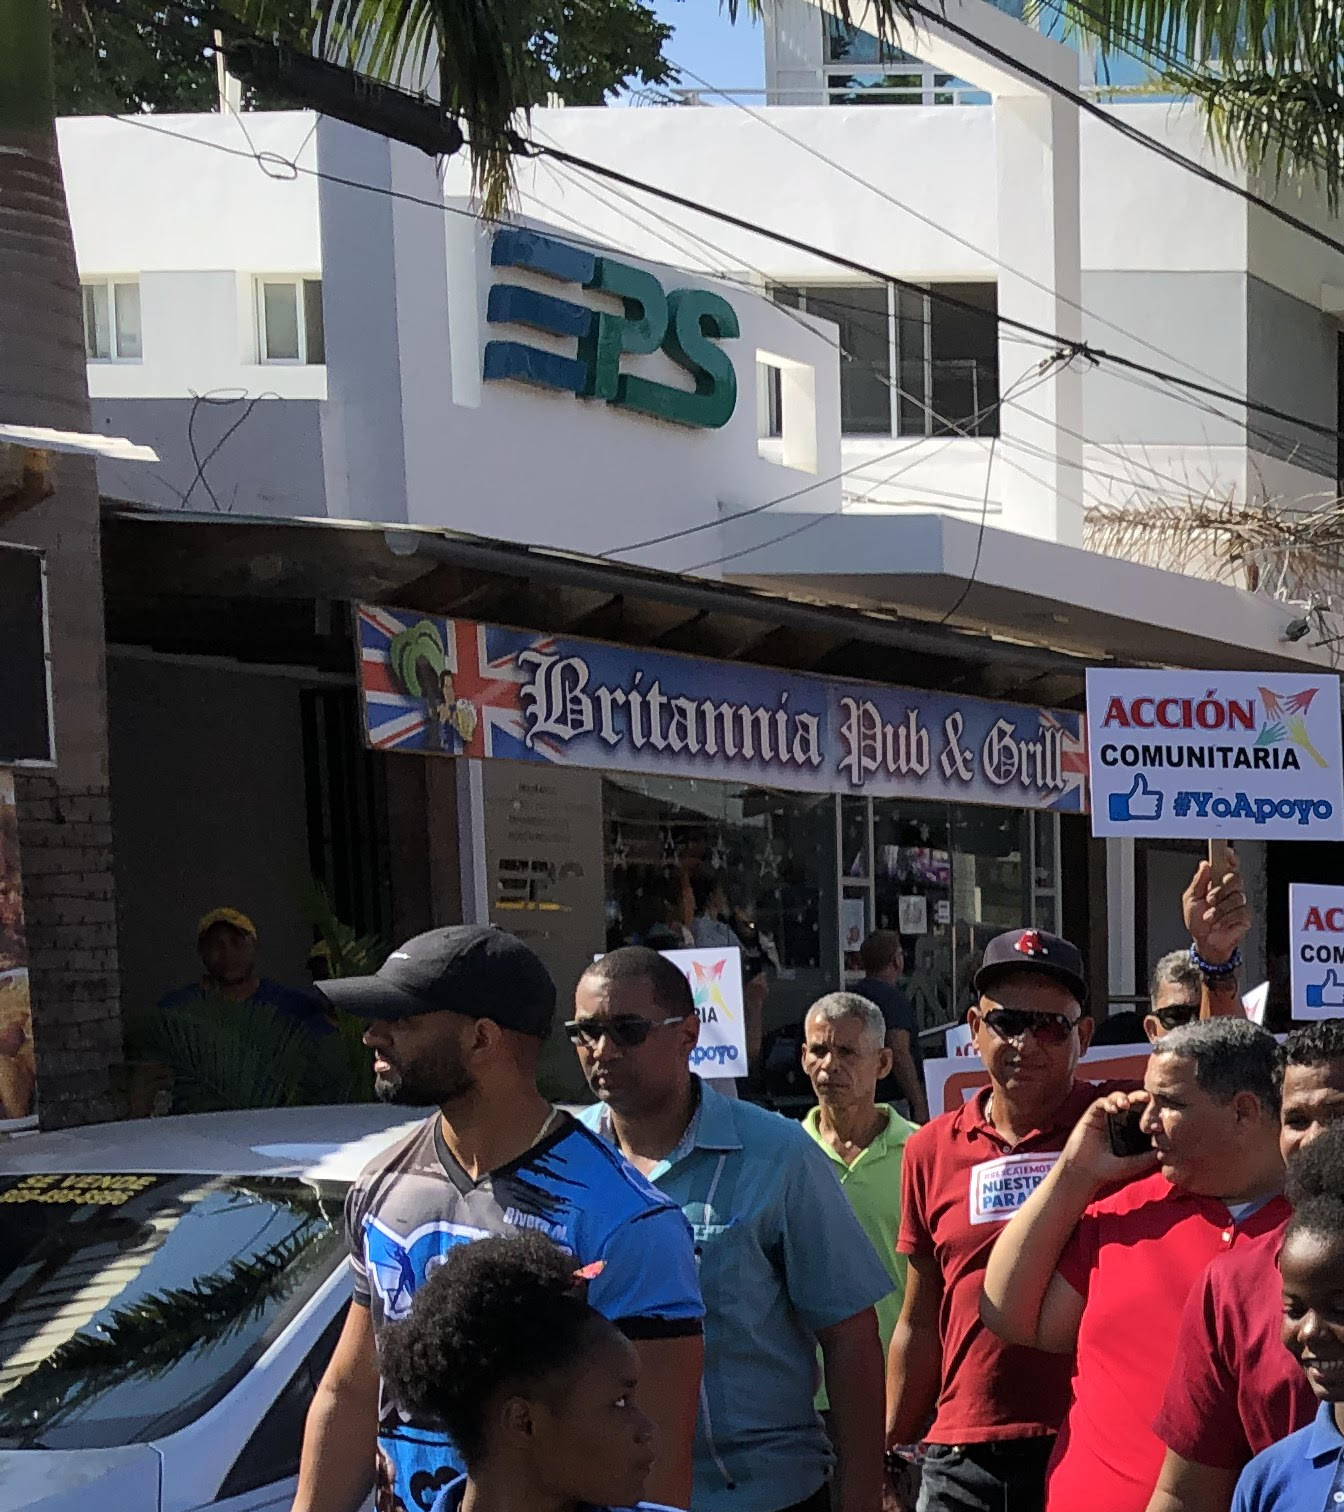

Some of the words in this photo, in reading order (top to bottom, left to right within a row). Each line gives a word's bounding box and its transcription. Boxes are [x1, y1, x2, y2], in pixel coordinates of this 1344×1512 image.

[484, 226, 740, 430] EPS
[517, 650, 823, 768] Britannia
[837, 696, 929, 785] Pub
[938, 729, 974, 780] &
[981, 718, 1078, 792] Grill
[1101, 687, 1256, 731] ACCIÓN
[1101, 744, 1301, 770] COMUNITARIA
[1173, 791, 1333, 824] #YoApoyo
